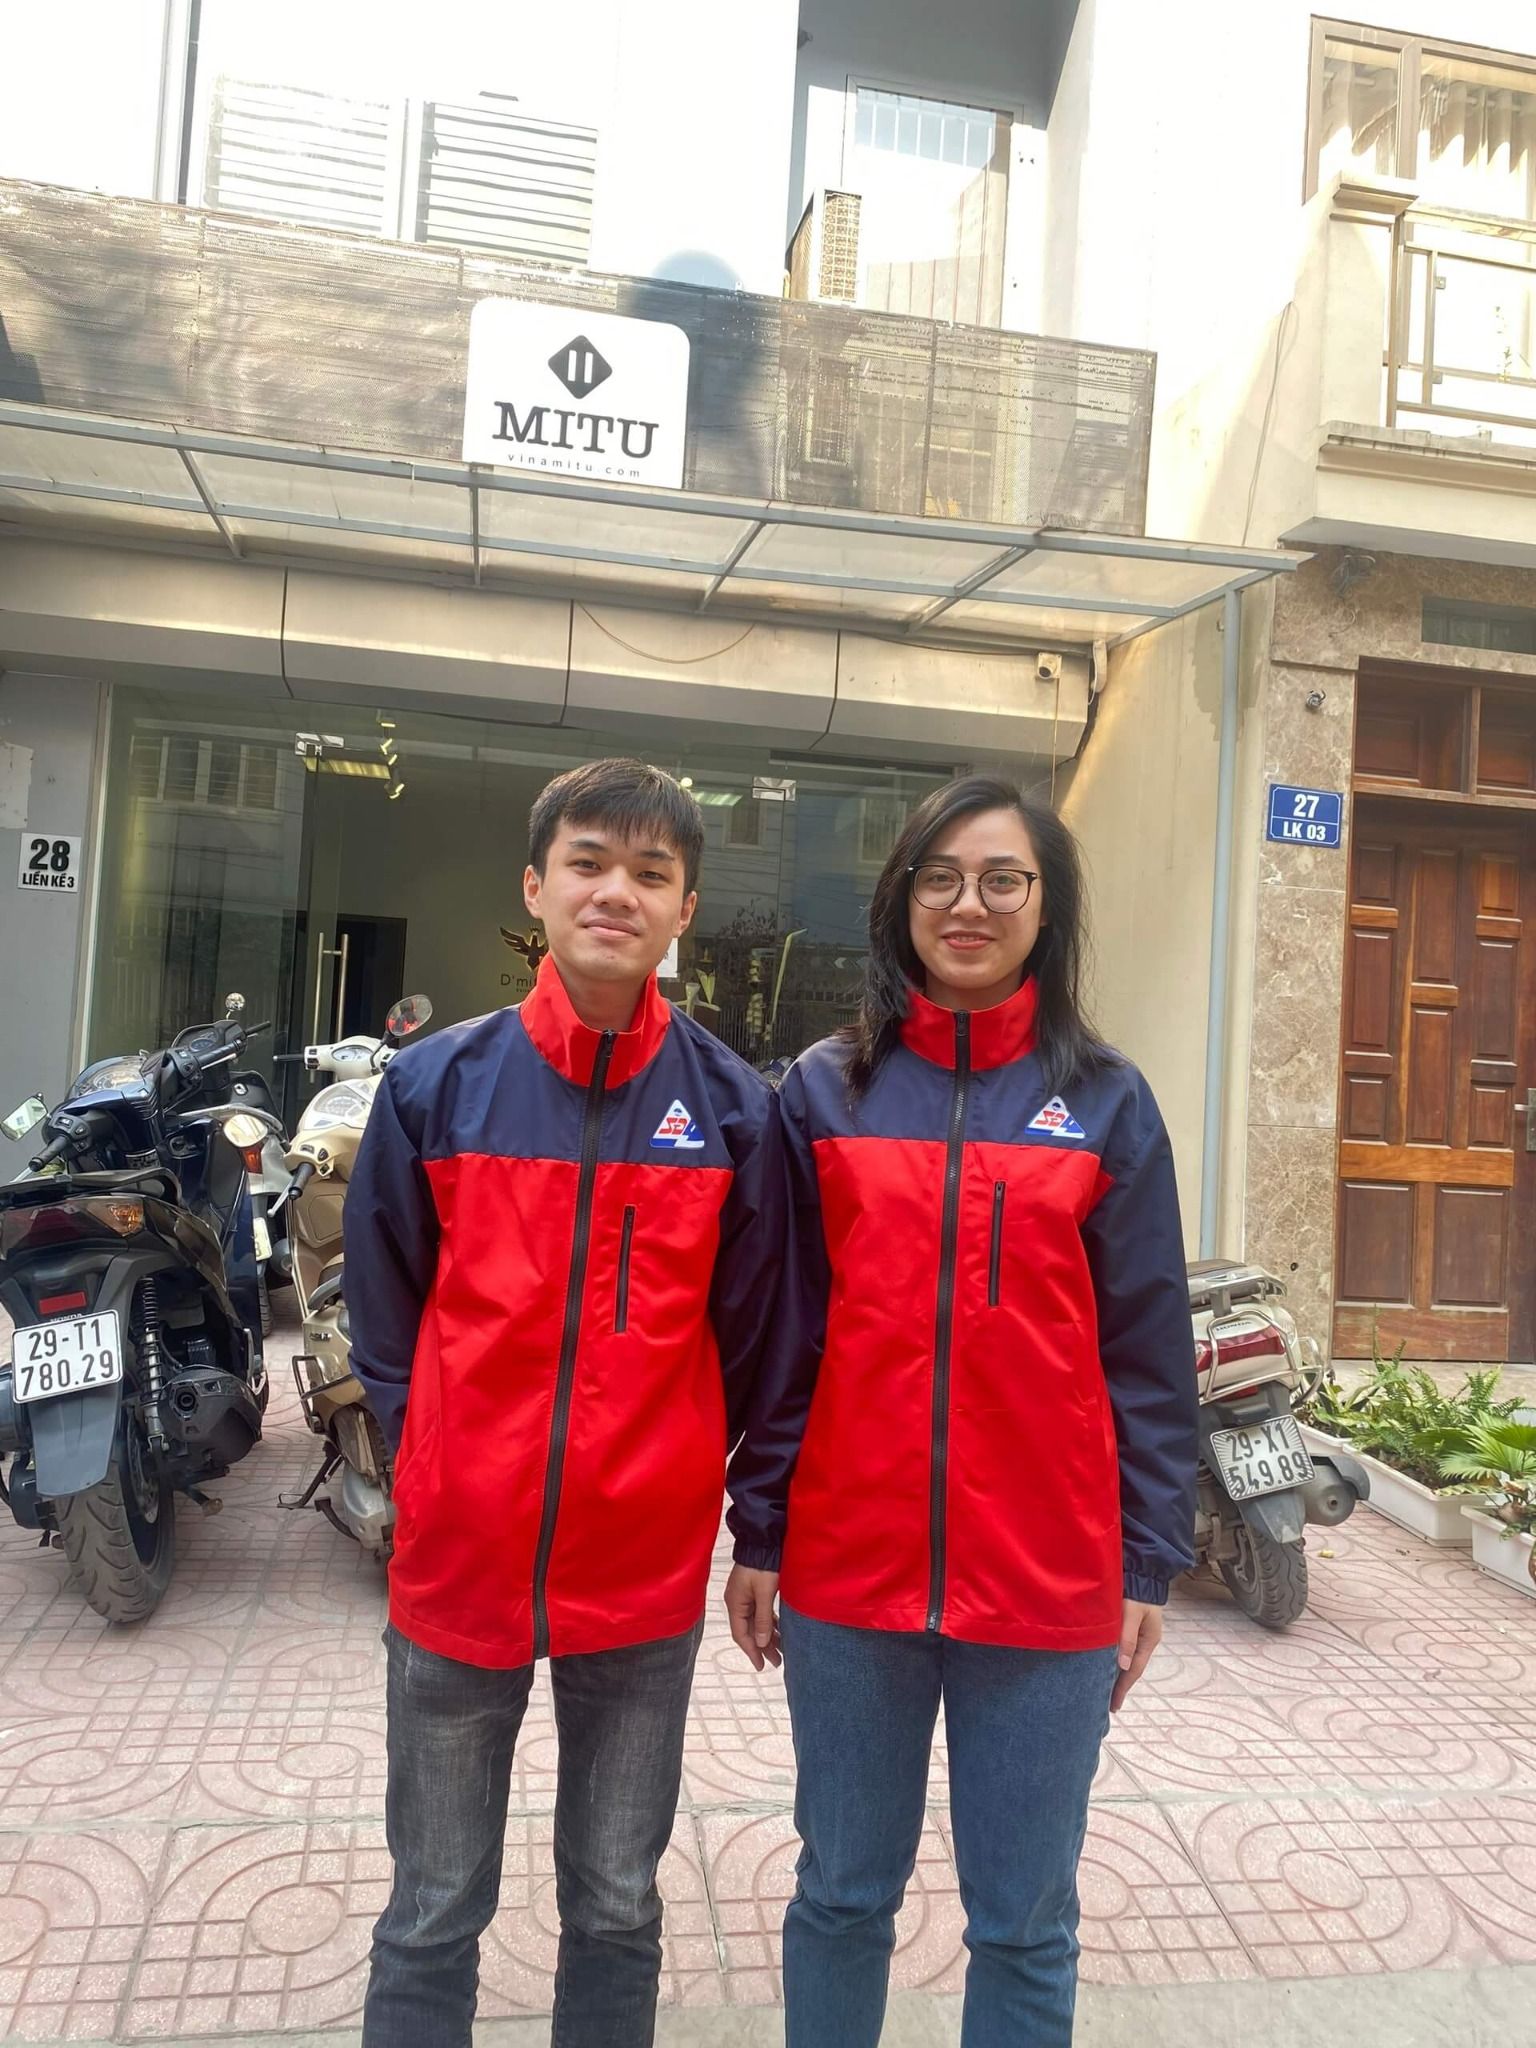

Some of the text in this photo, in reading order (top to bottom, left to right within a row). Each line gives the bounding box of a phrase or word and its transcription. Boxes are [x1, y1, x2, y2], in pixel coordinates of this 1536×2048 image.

[492, 401, 660, 459] MITU
[1293, 793, 1320, 819] 27
[1282, 821, 1327, 841] LK 03
[28, 838, 71, 872] 28
[28, 1318, 101, 1361] 29-T1
[21, 1349, 114, 1397] 780.29
[1225, 1422, 1290, 1462] 29-X1
[1227, 1450, 1308, 1495] 549.89
